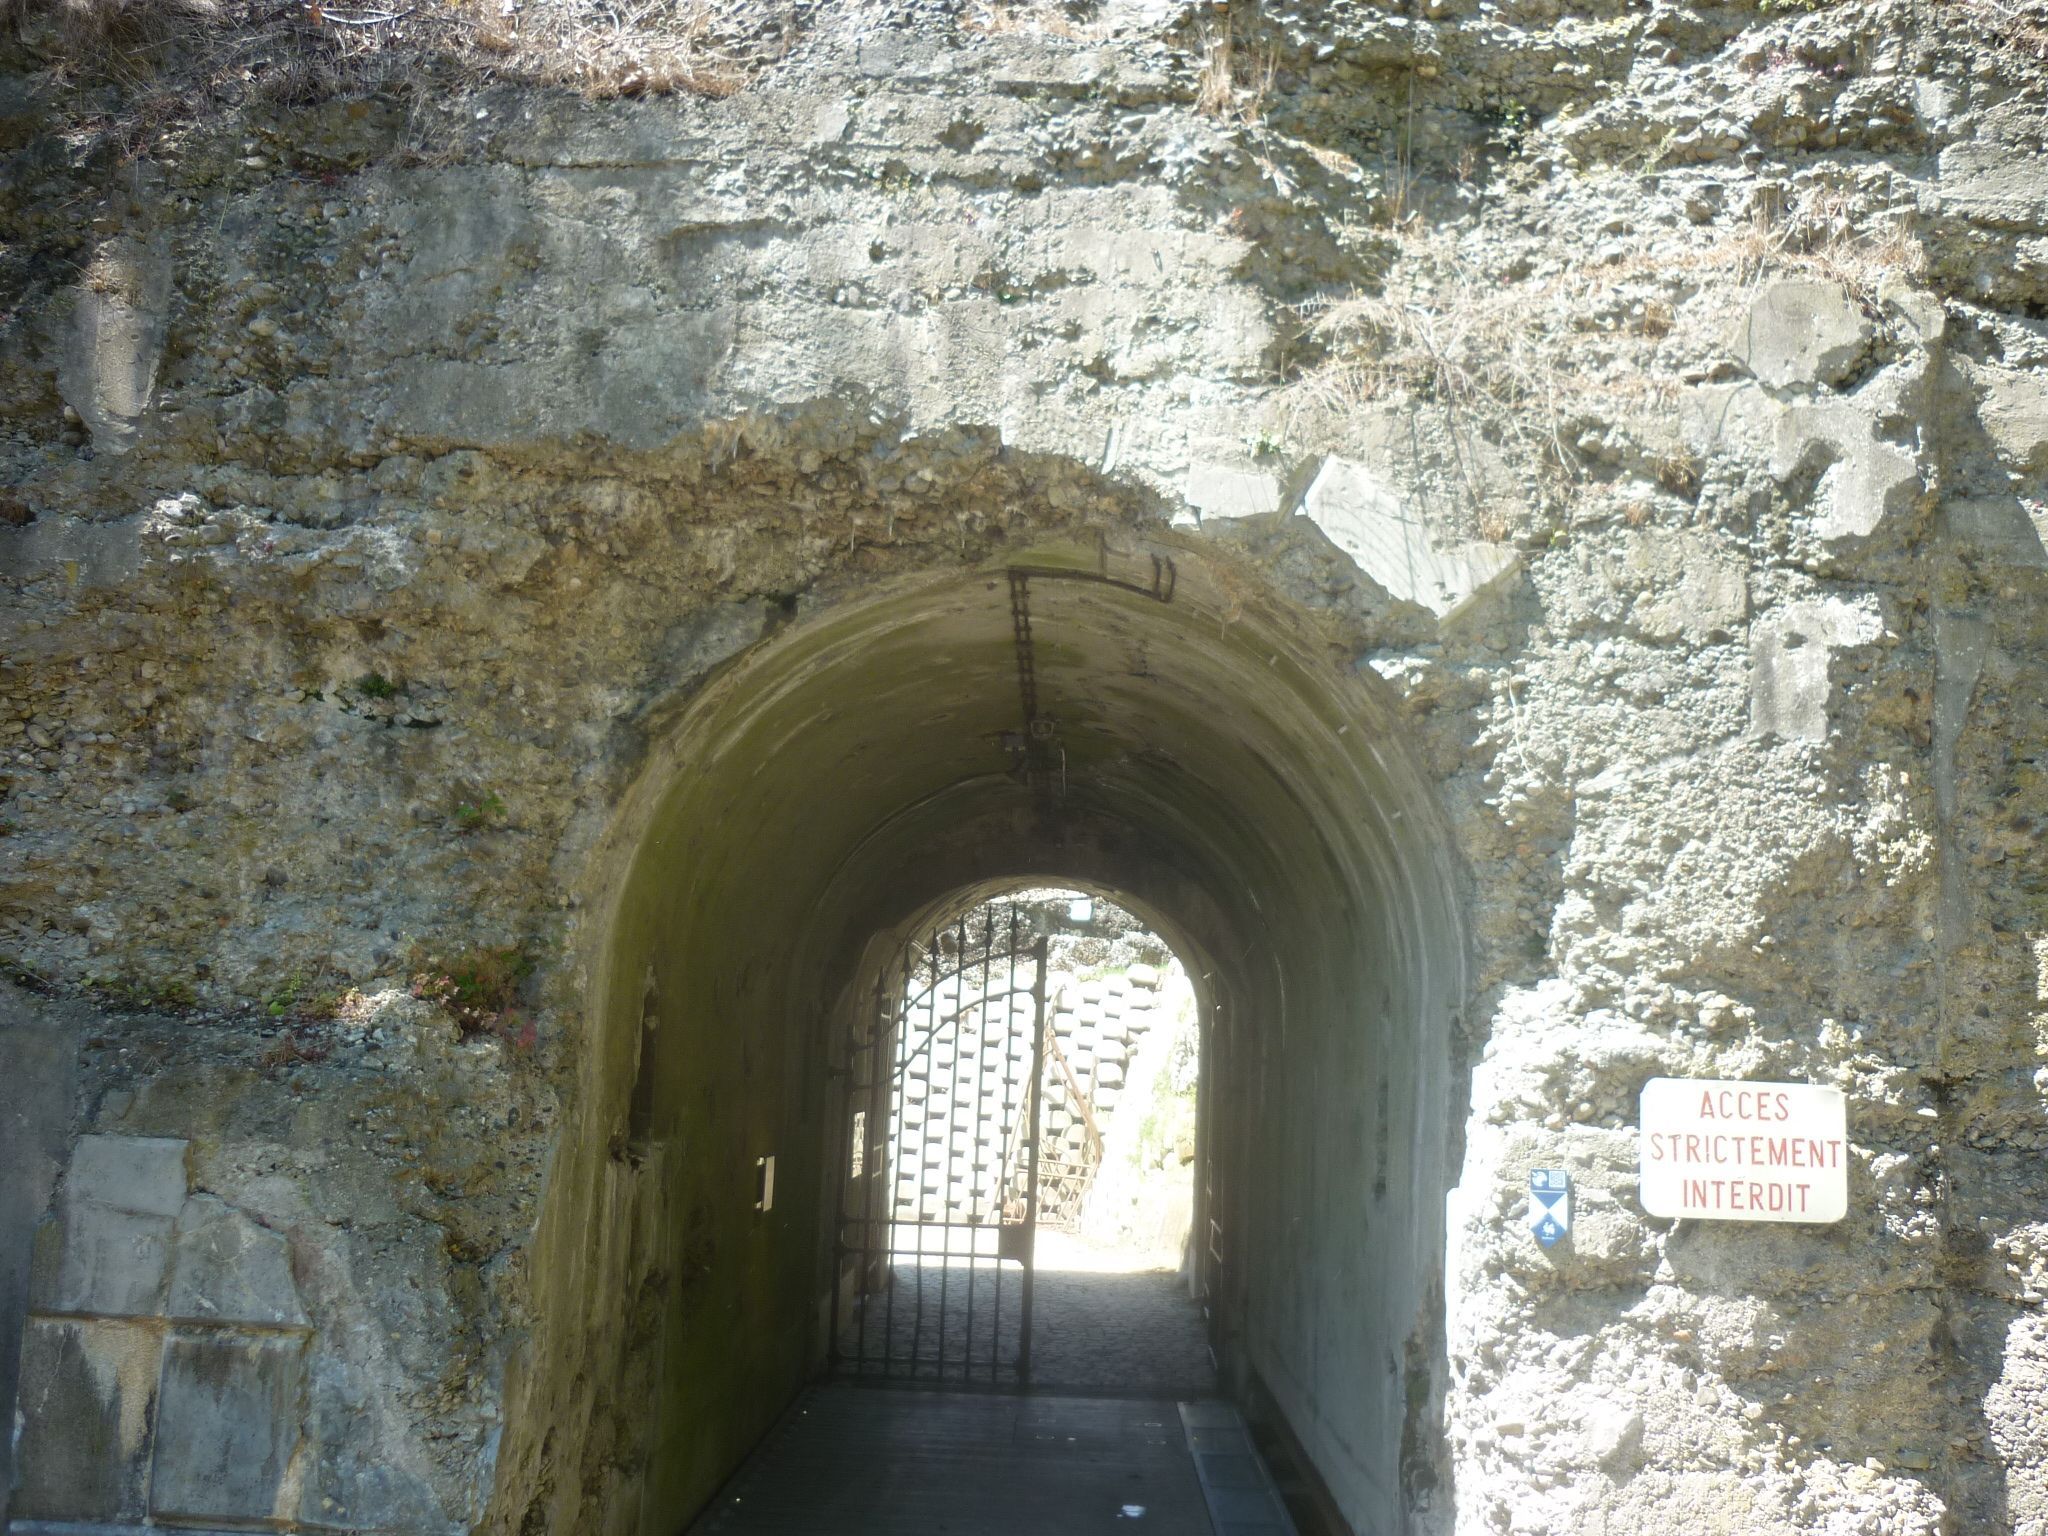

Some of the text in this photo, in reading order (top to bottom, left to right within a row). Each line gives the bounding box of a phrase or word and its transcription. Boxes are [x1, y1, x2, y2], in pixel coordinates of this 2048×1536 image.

[1700, 1090, 1789, 1121] ACCES
[1650, 1132, 1841, 1168] STRICTEMENT
[1683, 1179, 1811, 1212] INTERDIT
